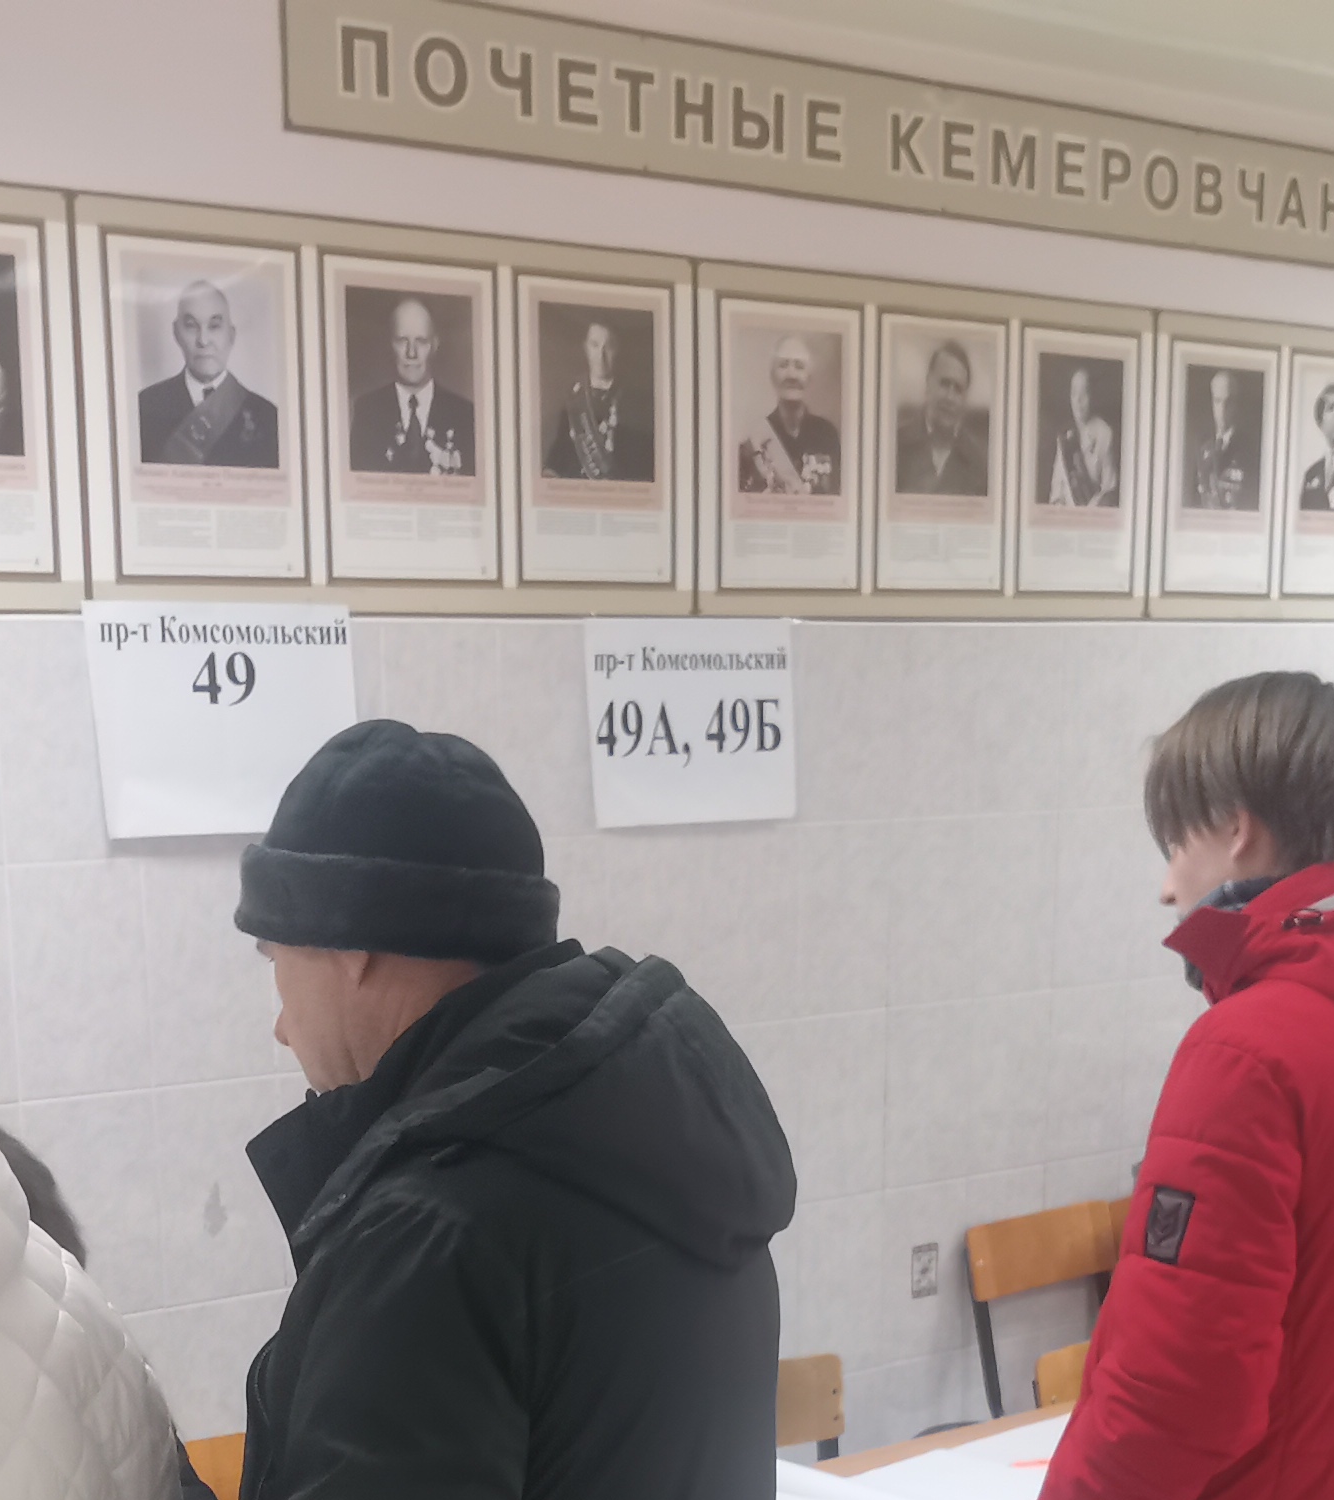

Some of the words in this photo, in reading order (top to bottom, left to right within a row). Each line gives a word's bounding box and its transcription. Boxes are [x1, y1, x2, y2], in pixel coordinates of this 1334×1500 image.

[340, 25, 843, 163] ПОЧЕТНЫЕ
[100, 621, 151, 651] пр-т
[158, 615, 348, 645] Комсомольский
[192, 651, 257, 707] 49
[594, 652, 635, 679] пр-т
[641, 646, 788, 672] Комсомольский
[596, 699, 692, 769] 49А,
[705, 698, 782, 754] 49Б
